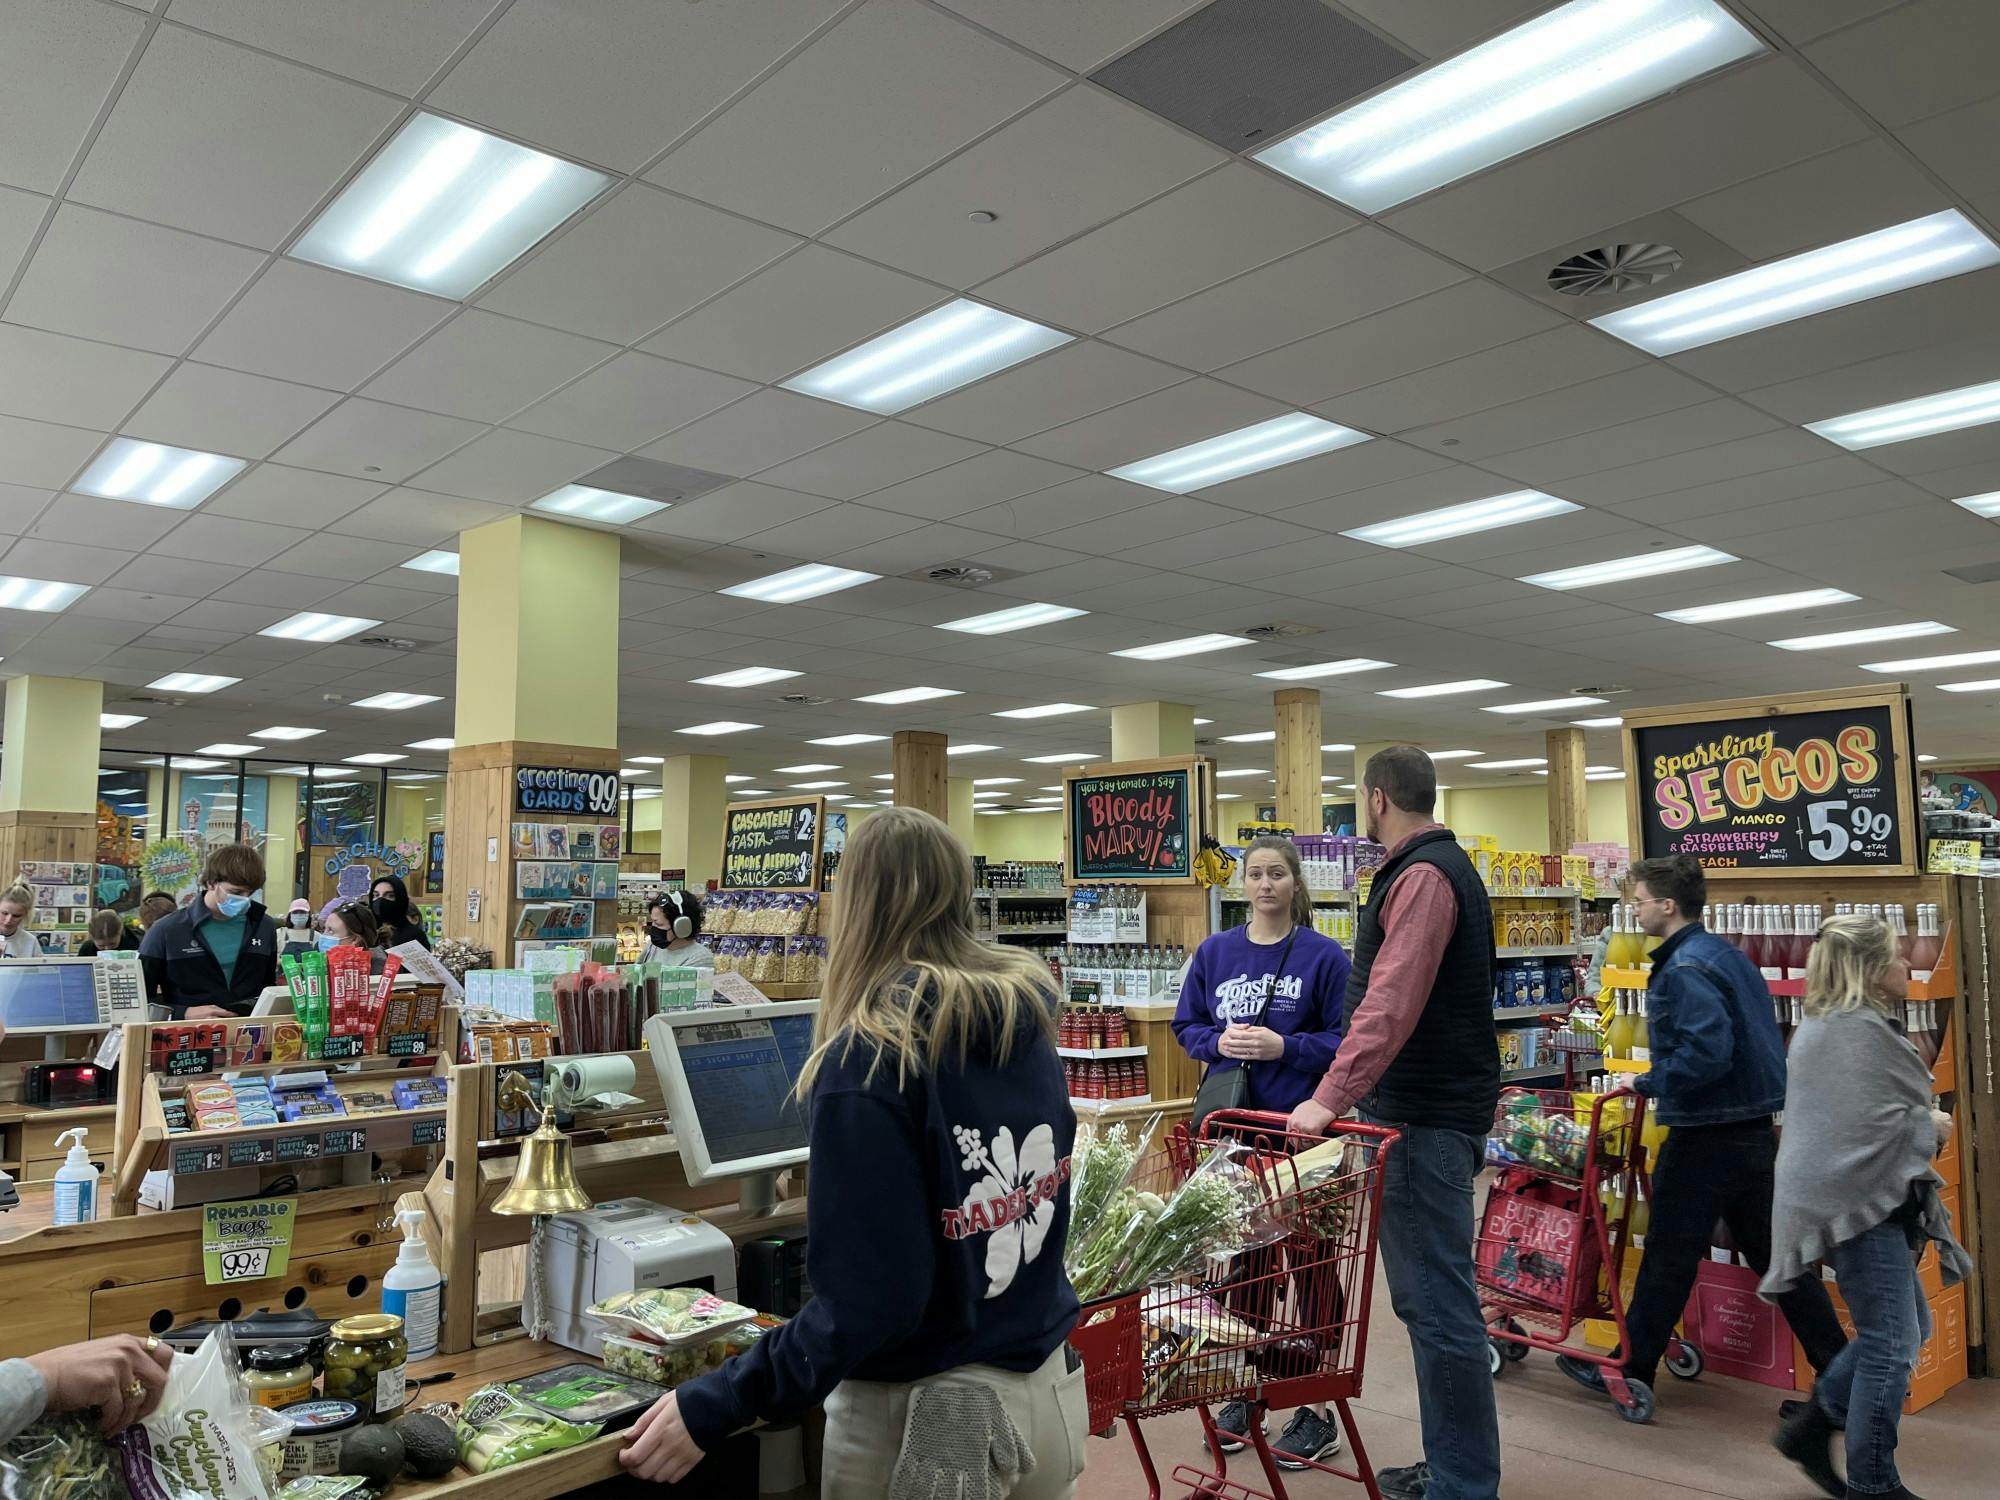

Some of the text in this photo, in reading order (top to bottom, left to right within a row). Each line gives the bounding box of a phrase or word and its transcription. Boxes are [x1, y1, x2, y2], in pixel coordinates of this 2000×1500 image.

[1654, 731, 1774, 778] Sparkling
[517, 768, 590, 792] greeting
[1081, 783, 1097, 796] you
[1099, 781, 1115, 792] say
[1158, 776, 1175, 789] say
[1656, 726, 1877, 830] SECCOS
[522, 789, 585, 811] CARDS
[1087, 789, 1174, 829] Bloody
[1731, 813, 1786, 826] MANGO
[728, 831, 771, 852] PASTA
[1085, 825, 1163, 871] MARY!
[1670, 842, 1766, 853] & RASPBERRY
[1683, 831, 1780, 845] STRAWBERRY
[325, 842, 410, 879] ORCHIDS
[1698, 857, 1737, 868] EACH
[734, 870, 771, 887] SAUCE
[170, 1056, 207, 1067] CARDS
[176, 1050, 198, 1060] GIFT
[325, 1131, 352, 1140] GREEN
[328, 1138, 344, 1146] TEA
[1505, 1200, 1572, 1238] BUFFALO
[224, 1253, 261, 1276] 99¢
[184, 1409, 230, 1500] Cruciferou
